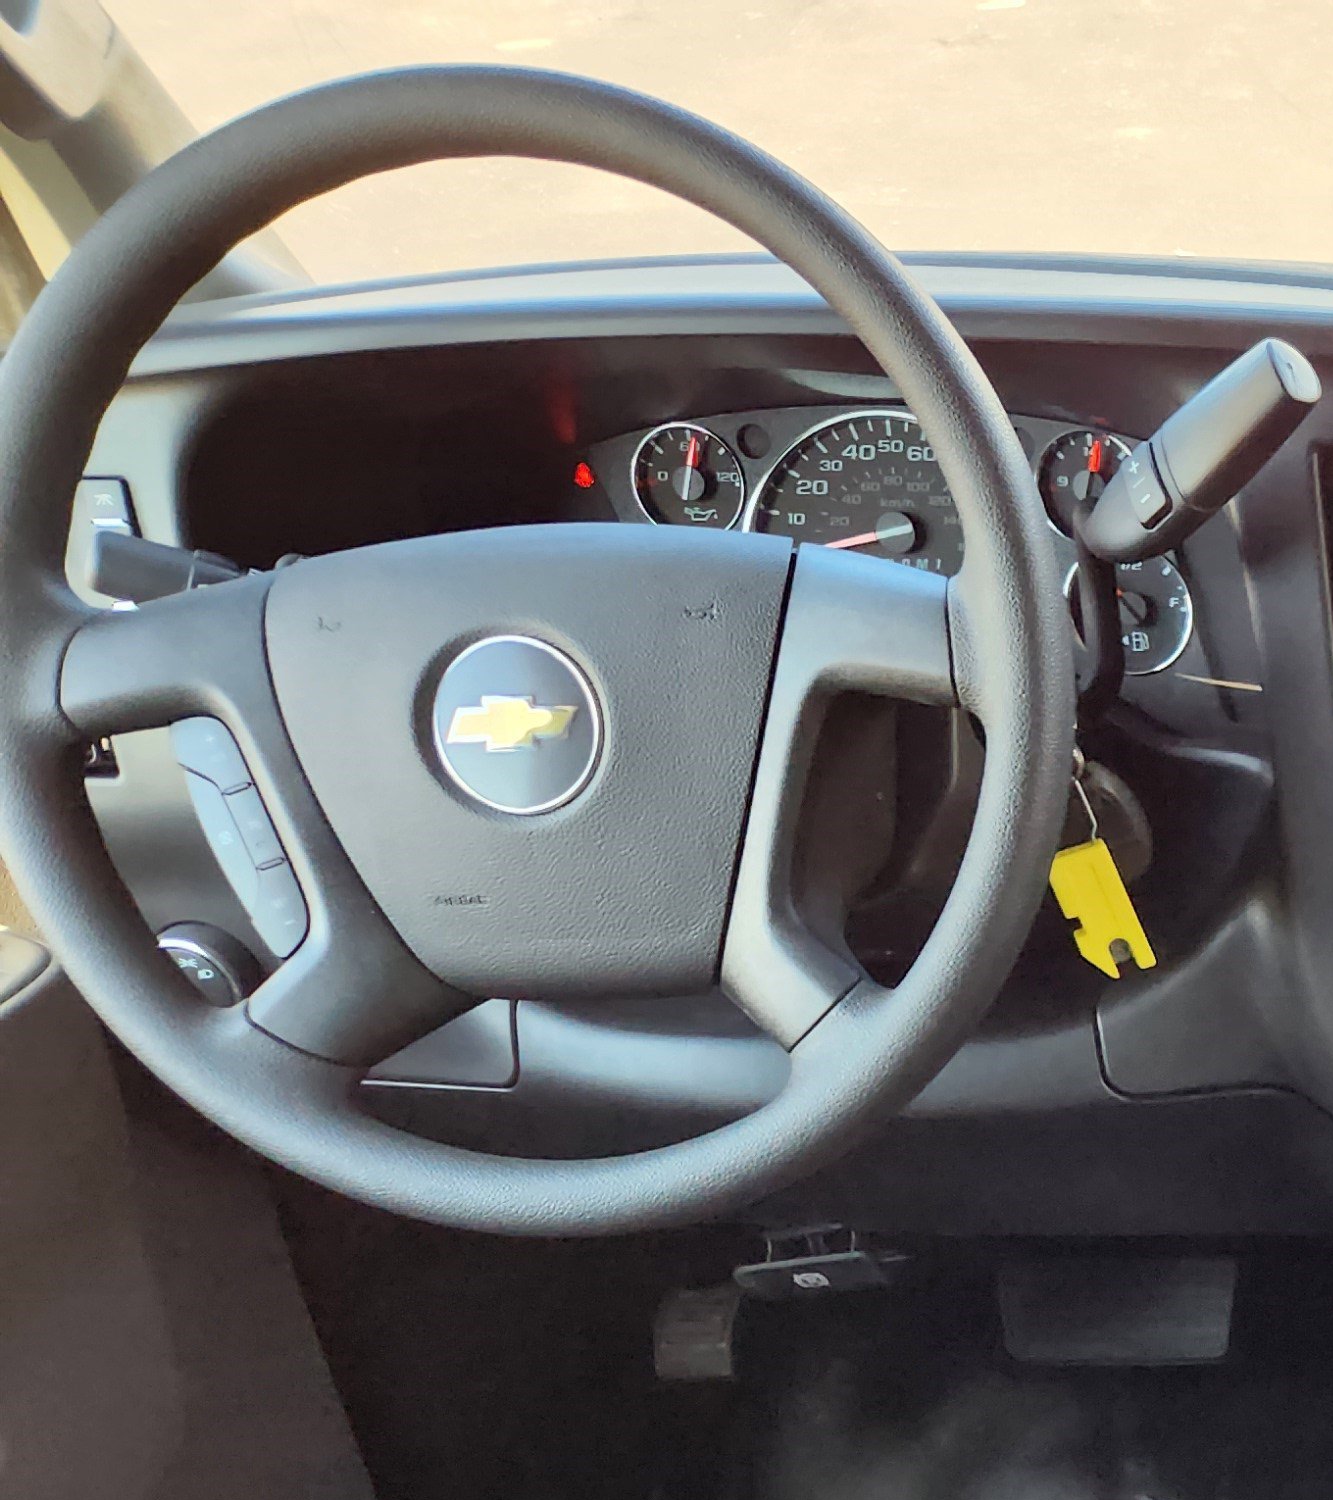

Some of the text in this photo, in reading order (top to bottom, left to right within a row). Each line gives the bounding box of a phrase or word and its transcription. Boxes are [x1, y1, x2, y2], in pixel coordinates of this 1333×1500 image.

[841, 444, 876, 461] 40
[878, 440, 904, 453] 50
[906, 446, 936, 462] 60
[819, 460, 843, 472] 30
[657, 470, 669, 482] 0
[716, 471, 739, 483] 120
[1057, 475, 1069, 487] 9
[795, 480, 828, 495] 20
[788, 512, 805, 525] 10
